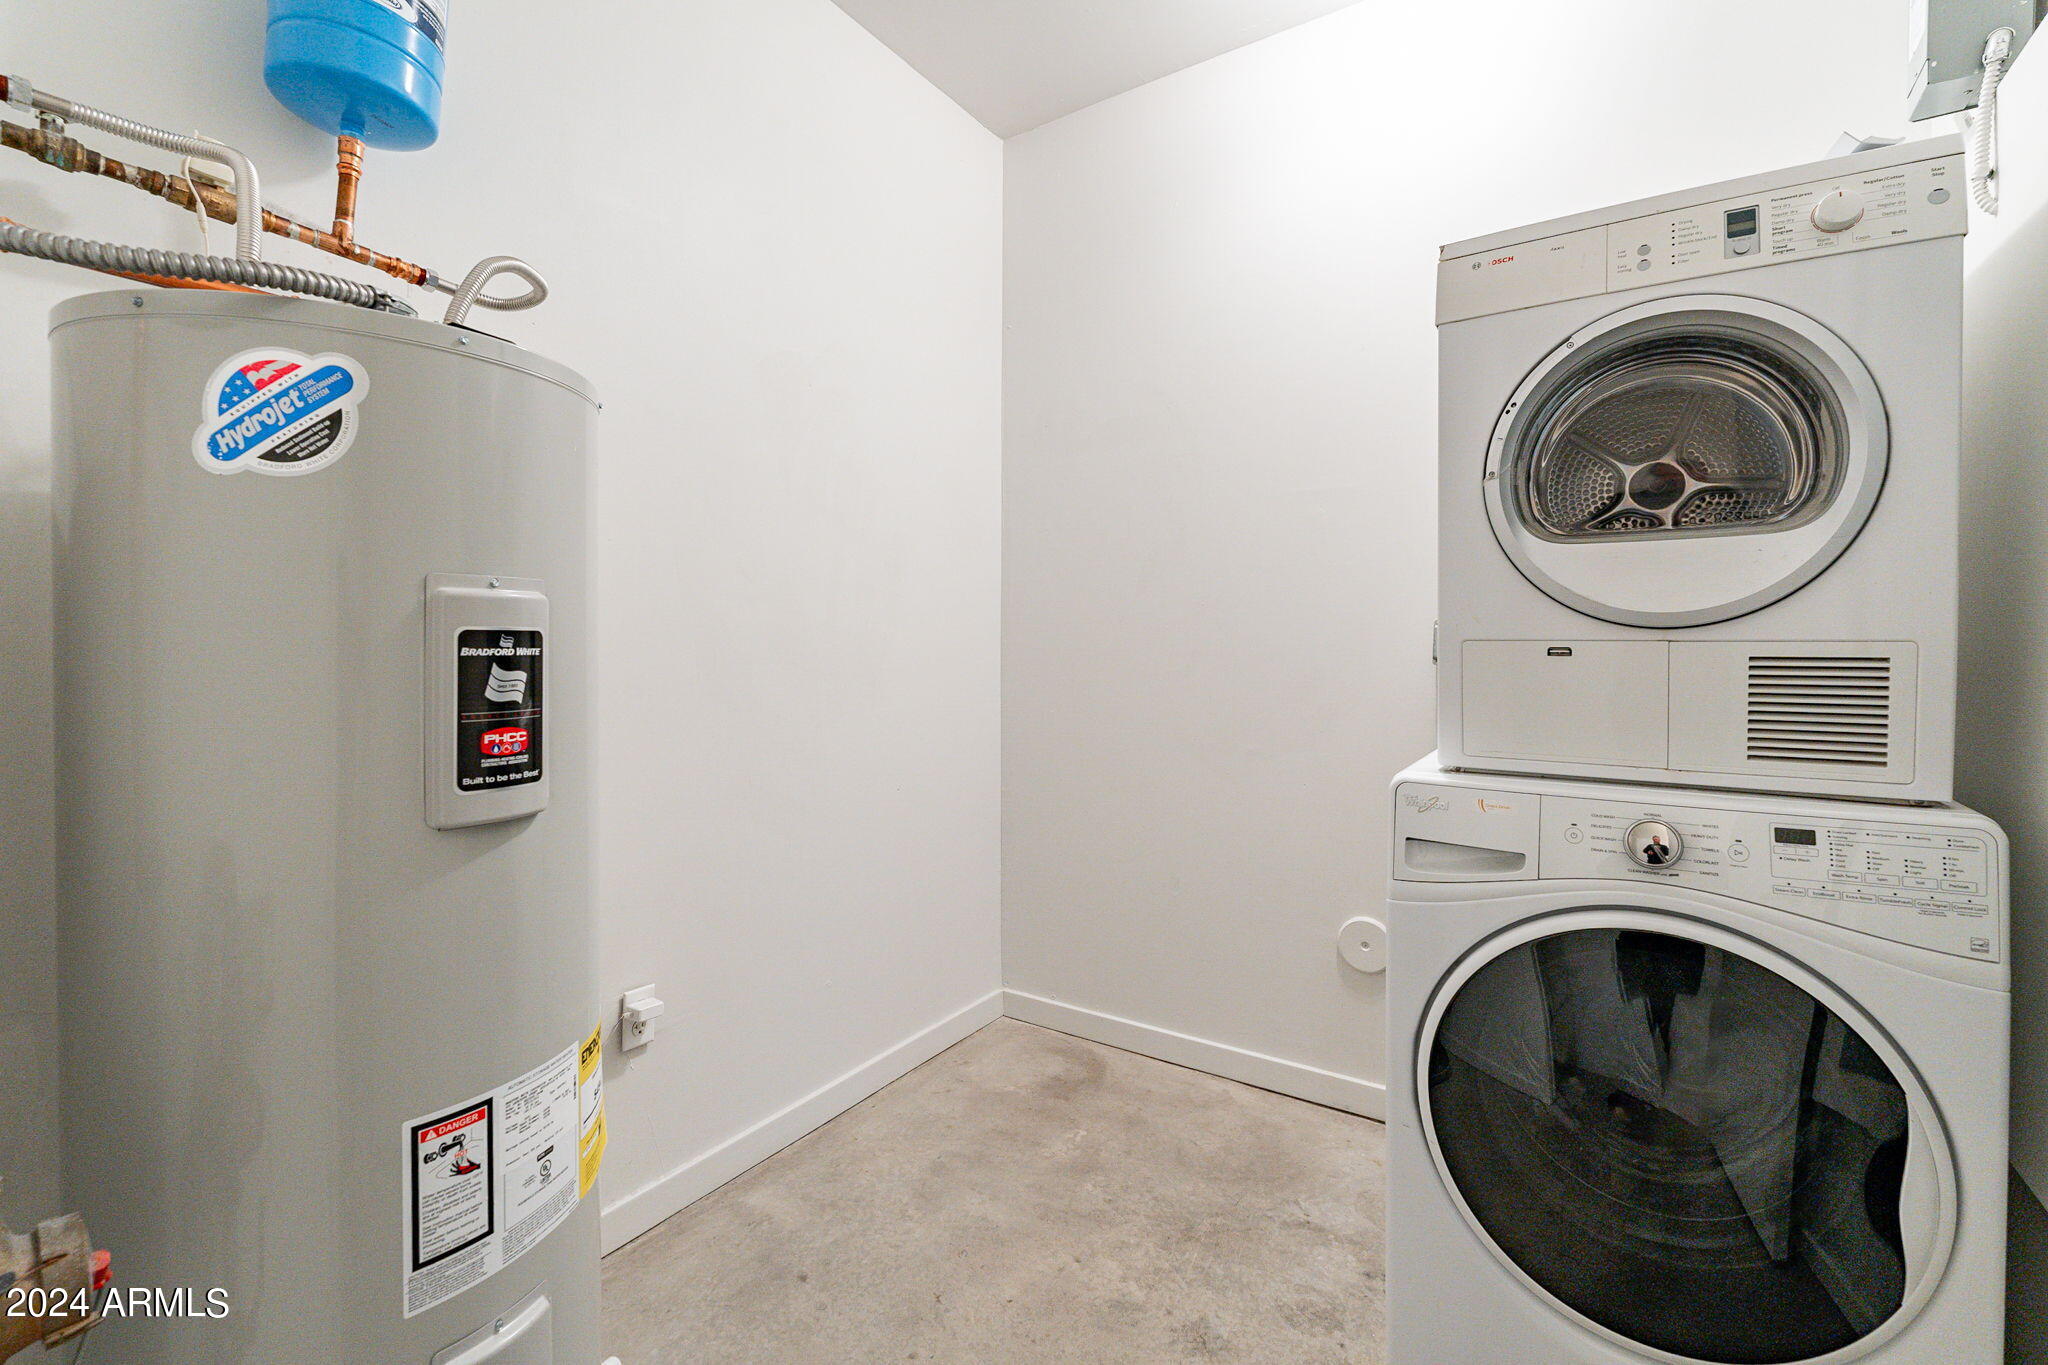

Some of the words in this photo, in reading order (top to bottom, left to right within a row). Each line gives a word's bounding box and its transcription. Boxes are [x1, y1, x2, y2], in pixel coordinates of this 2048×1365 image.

[298, 378, 316, 391] TOTAL
[306, 388, 331, 404] SYSTEM
[214, 388, 304, 454] Hydrojet
[306, 451, 330, 468] WHITE
[328, 410, 352, 455] CORPORATION
[460, 646, 515, 657] BRADFORD
[516, 646, 542, 656] WHITE
[484, 731, 528, 744] PHCC
[462, 774, 484, 786] Built
[485, 776, 496, 784] to
[496, 774, 508, 782] be
[509, 771, 523, 781] the
[523, 769, 539, 778] Best
[438, 1112, 480, 1136] DANGER
[454, 1148, 468, 1160] HOT
